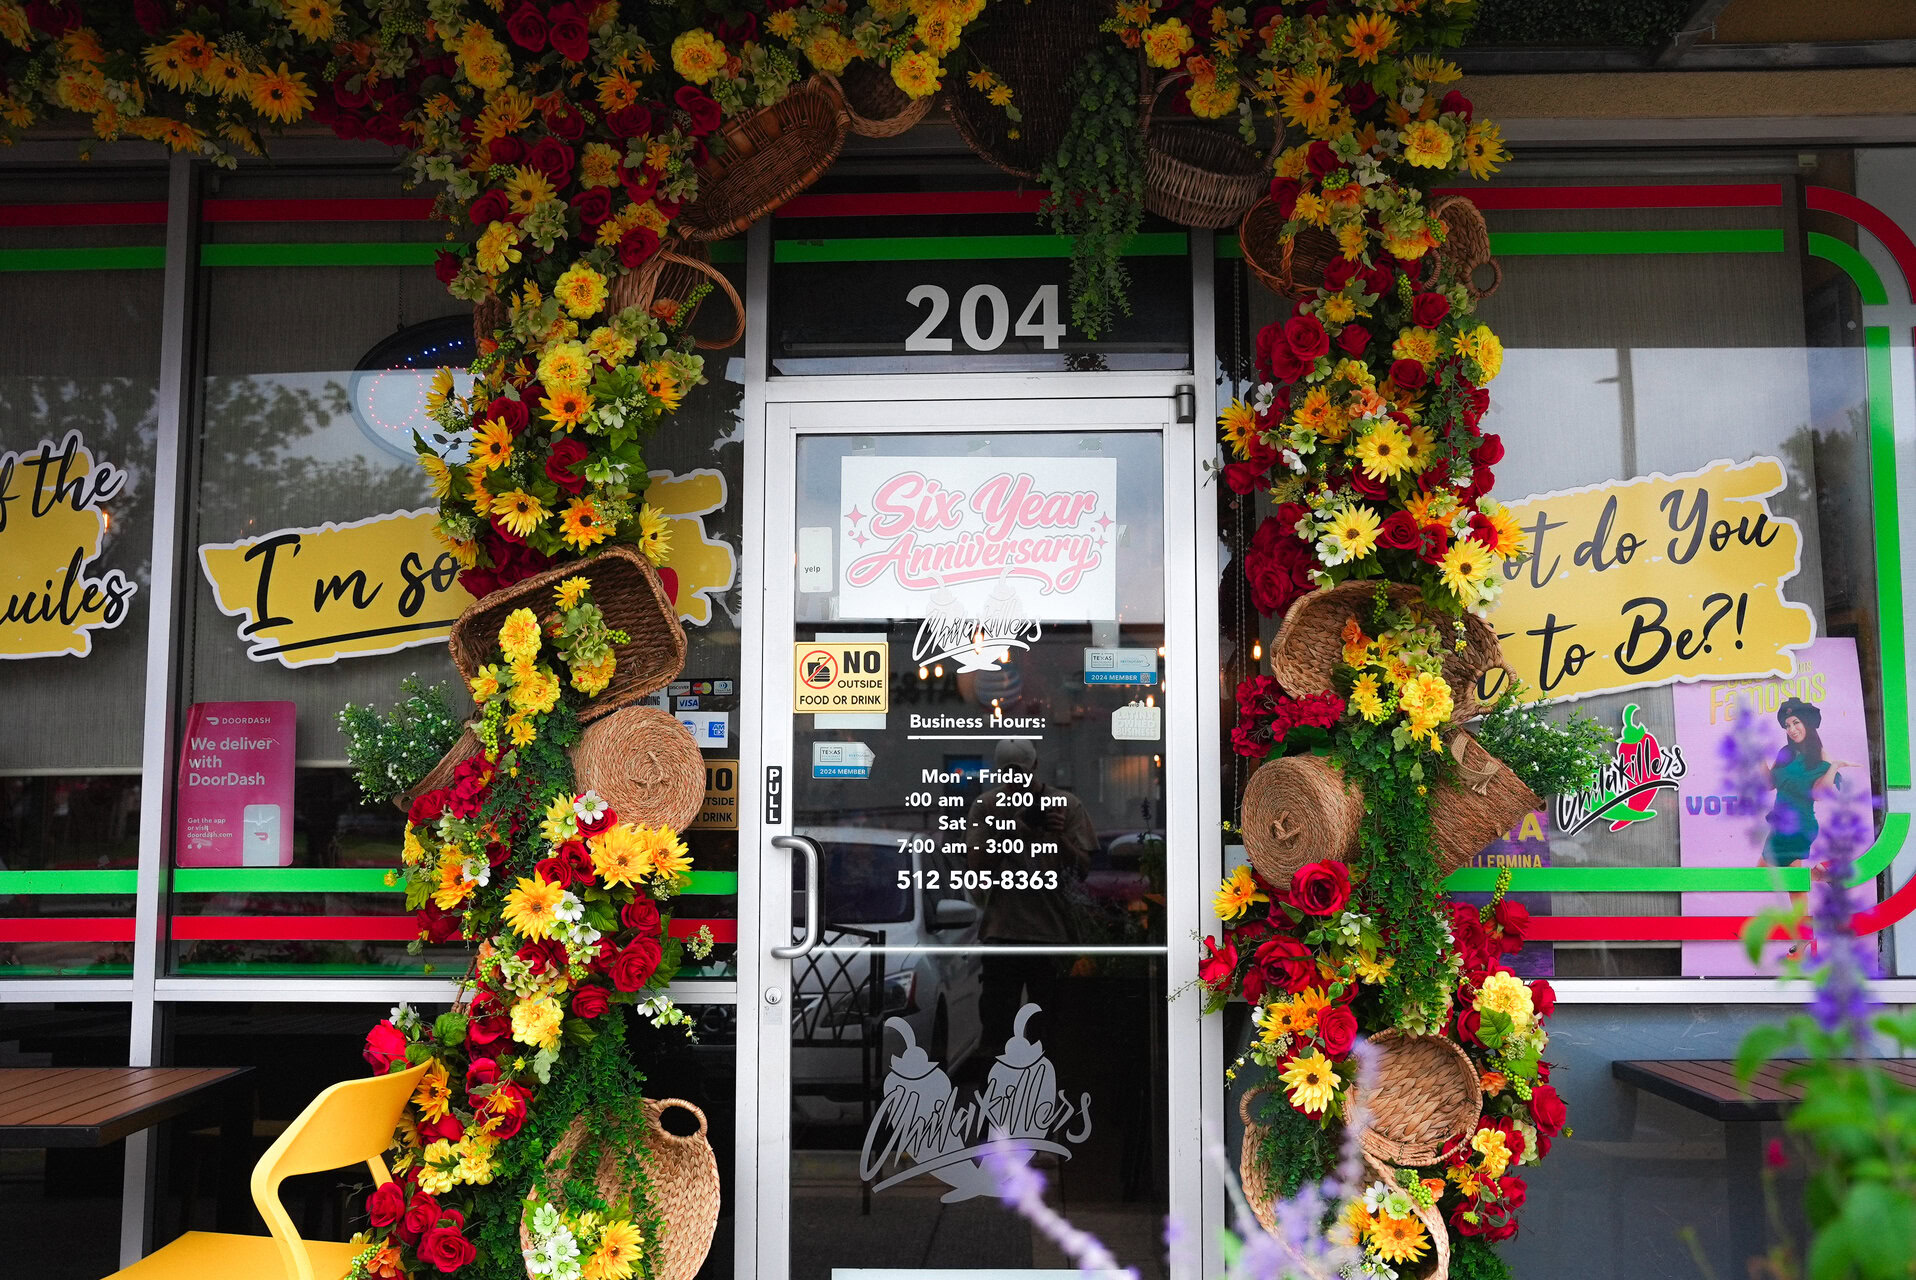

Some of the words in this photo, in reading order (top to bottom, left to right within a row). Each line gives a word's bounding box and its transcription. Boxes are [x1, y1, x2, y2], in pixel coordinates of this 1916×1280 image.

[904, 284, 1067, 352] 204
[23, 435, 123, 518] the
[871, 472, 965, 538] Six
[970, 473, 1098, 542] Year
[1574, 495, 1647, 572] do
[1660, 488, 1780, 565] You
[804, 565, 821, 574] yelp
[846, 532, 1102, 594] Anniversary
[0, 546, 133, 625] uiles
[244, 533, 384, 636] I'm
[1526, 613, 1596, 691] to
[1614, 592, 1748, 675] Be?!
[843, 650, 881, 674] NO
[837, 679, 883, 689] OUTSIDE
[799, 695, 829, 705] FOOD
[833, 695, 848, 705] OR
[851, 695, 881, 705] DRINK
[909, 714, 983, 729] Business
[989, 714, 1046, 729] Hours:
[190, 737, 216, 750] We
[220, 737, 272, 750] deliver
[189, 755, 222, 768] with
[189, 772, 265, 786] DoorDash
[921, 768, 960, 784] Mon
[979, 768, 1033, 787] Friday
[768, 769, 780, 822] PULL
[938, 796, 964, 807] am
[995, 792, 1033, 807] 2:00
[1040, 796, 1067, 811] pm
[1685, 795, 1740, 816] VOT
[702, 813, 733, 822] DRINK
[938, 815, 967, 831] Sat
[896, 838, 935, 854] 7:00
[941, 843, 967, 854] am
[985, 838, 1024, 854] 3:00
[1030, 843, 1058, 858] pm
[896, 870, 940, 890] 512
[949, 870, 1058, 890] 505-8363
[859, 1063, 1092, 1182] Chilakillers
